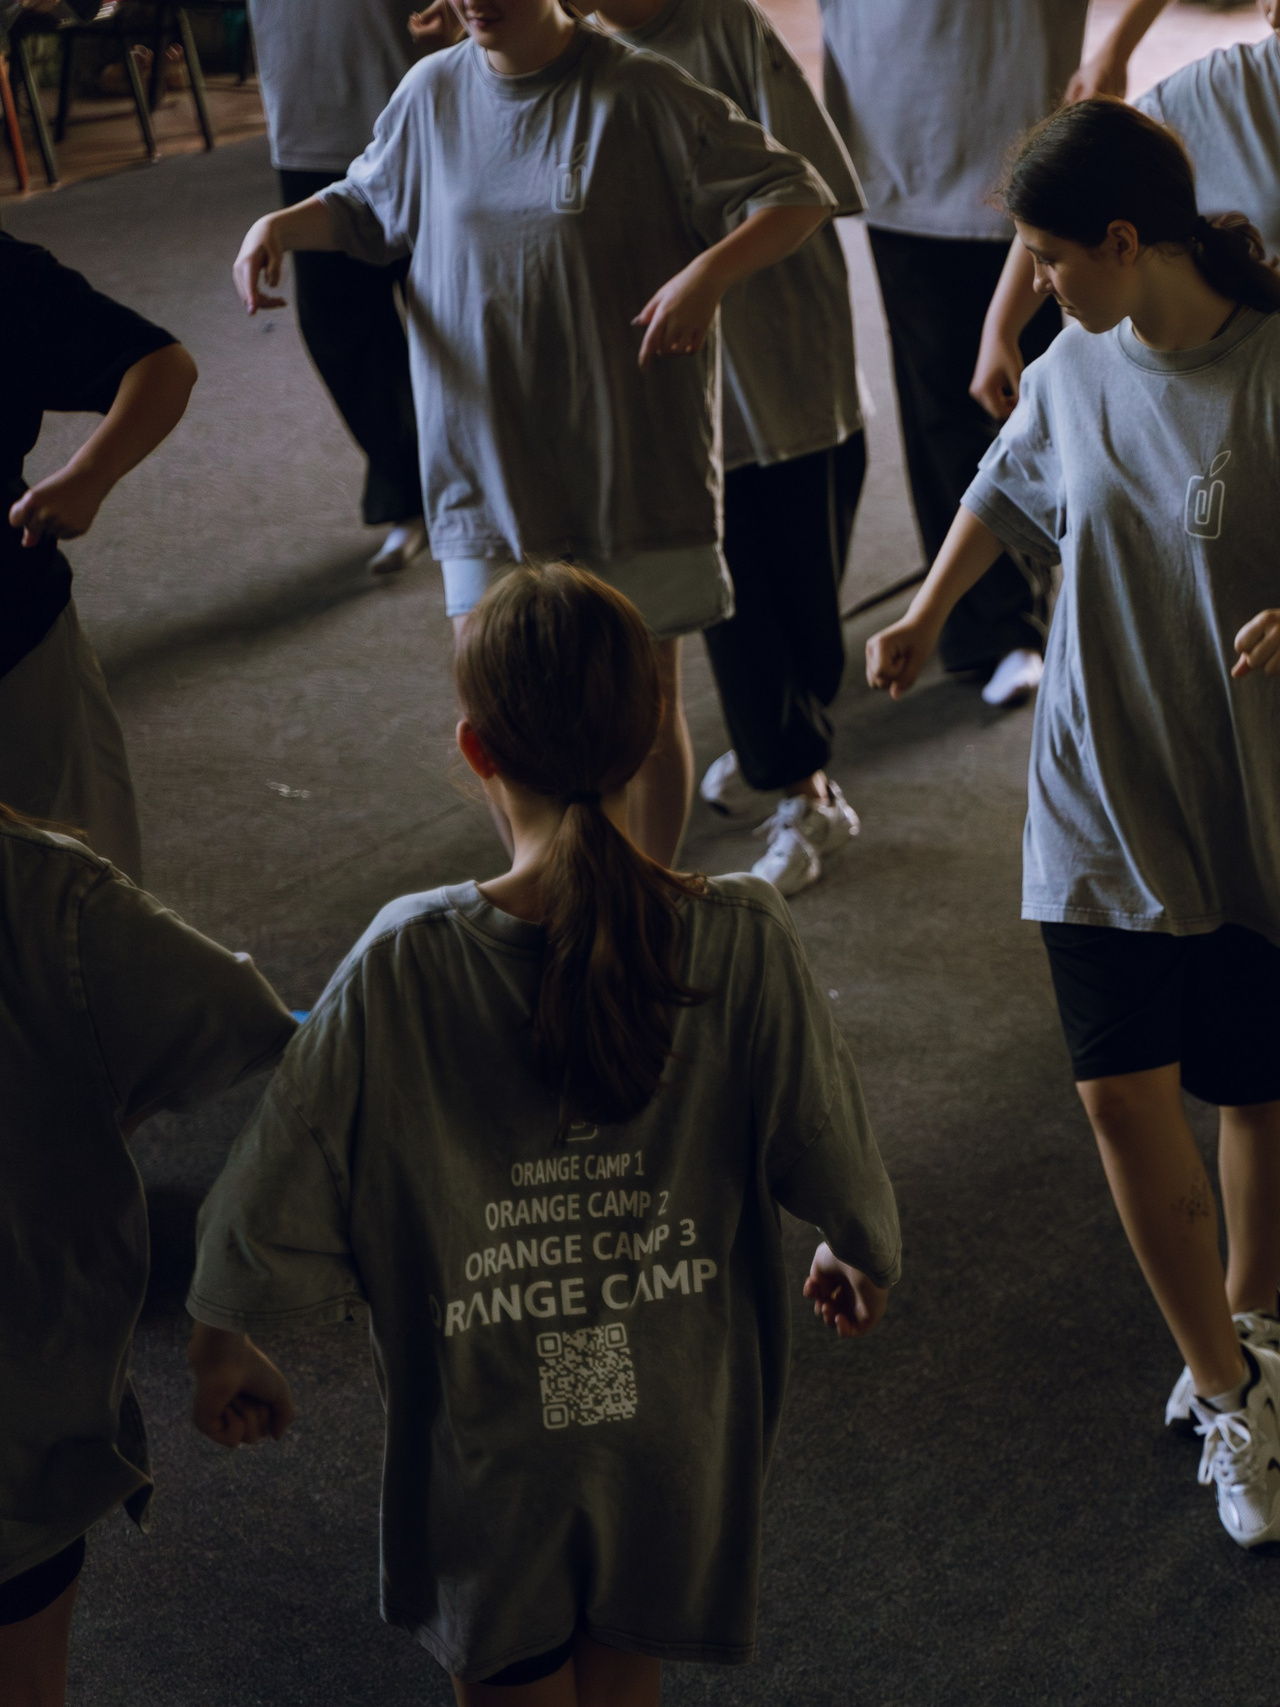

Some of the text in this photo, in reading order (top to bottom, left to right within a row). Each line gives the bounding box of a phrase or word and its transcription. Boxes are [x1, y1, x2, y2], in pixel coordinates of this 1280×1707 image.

[511, 1150, 645, 1187] ORANGE CAMP 1
[485, 1189, 669, 1231] ORANGE CAMP 2
[465, 1218, 697, 1281] ORANGE CAMP 3
[601, 1258, 718, 1310] CAMP
